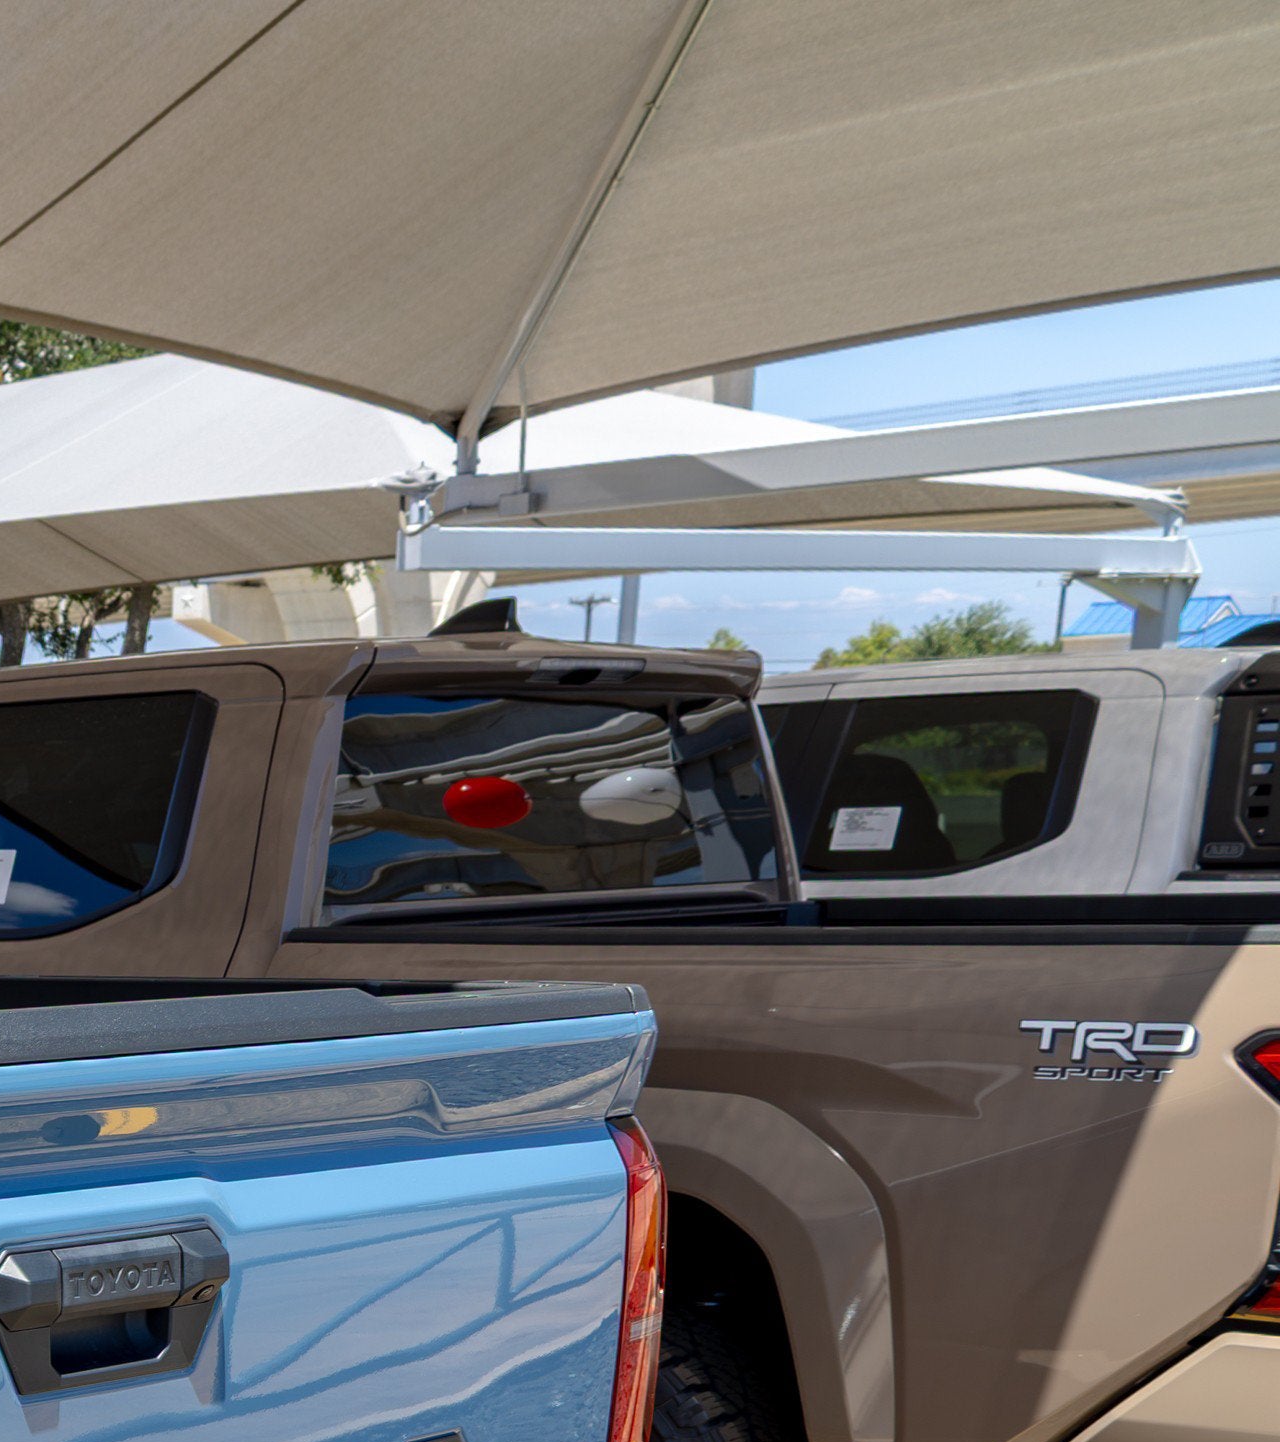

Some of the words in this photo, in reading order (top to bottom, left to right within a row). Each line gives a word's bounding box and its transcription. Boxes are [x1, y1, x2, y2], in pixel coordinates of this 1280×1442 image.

[1019, 1020, 1197, 1064] TRD
[1033, 1066, 1175, 1083] SPORT
[68, 1259, 177, 1299] TOYOTA
